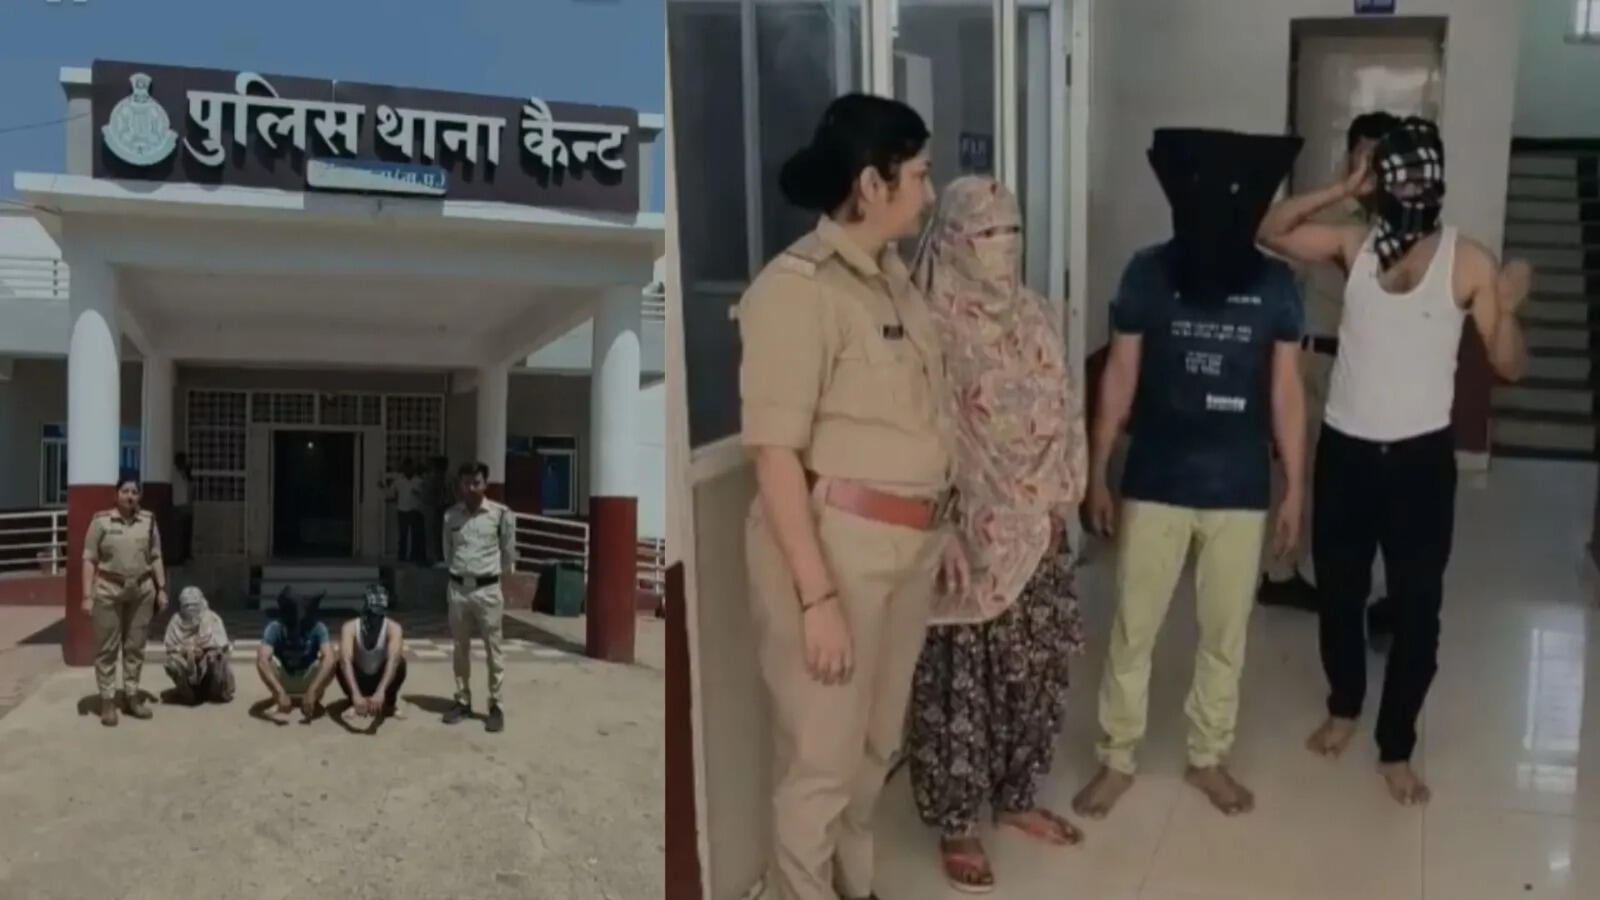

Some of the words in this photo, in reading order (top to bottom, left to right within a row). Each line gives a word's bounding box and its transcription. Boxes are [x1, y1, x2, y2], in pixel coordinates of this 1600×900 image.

[183, 72, 366, 167] पुलिस
[377, 105, 506, 166] थाना
[521, 97, 629, 171] कैन्ट
